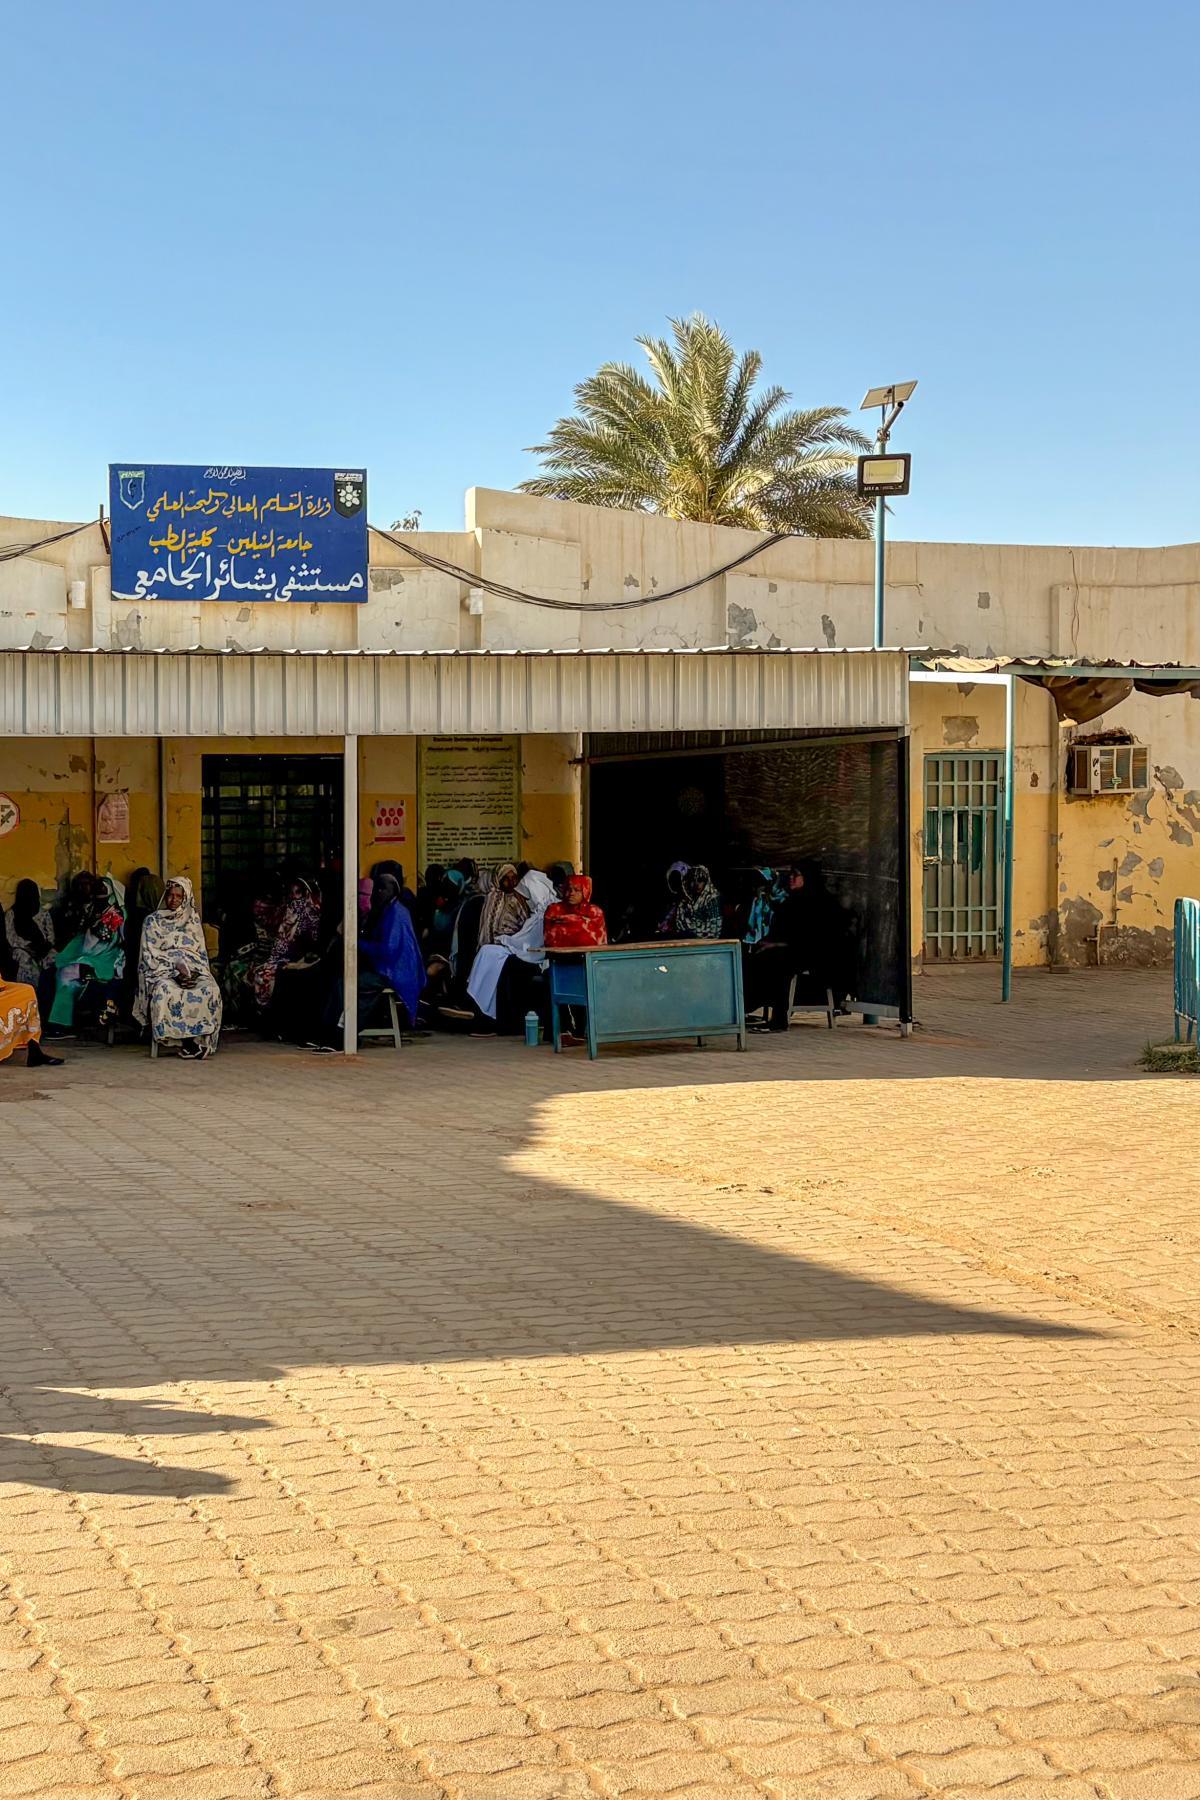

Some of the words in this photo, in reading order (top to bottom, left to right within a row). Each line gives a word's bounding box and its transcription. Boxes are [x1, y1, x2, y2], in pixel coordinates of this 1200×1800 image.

[146, 490, 185, 523] العلمي
[260, 490, 304, 524] التعليم
[304, 494, 332, 518] وزارة
[148, 522, 187, 565] الطب
[185, 526, 218, 554] كلية
[227, 528, 276, 559] النيلين
[276, 531, 313, 558] جامعة
[110, 551, 212, 601] الجامعي
[202, 555, 277, 600] بشائر
